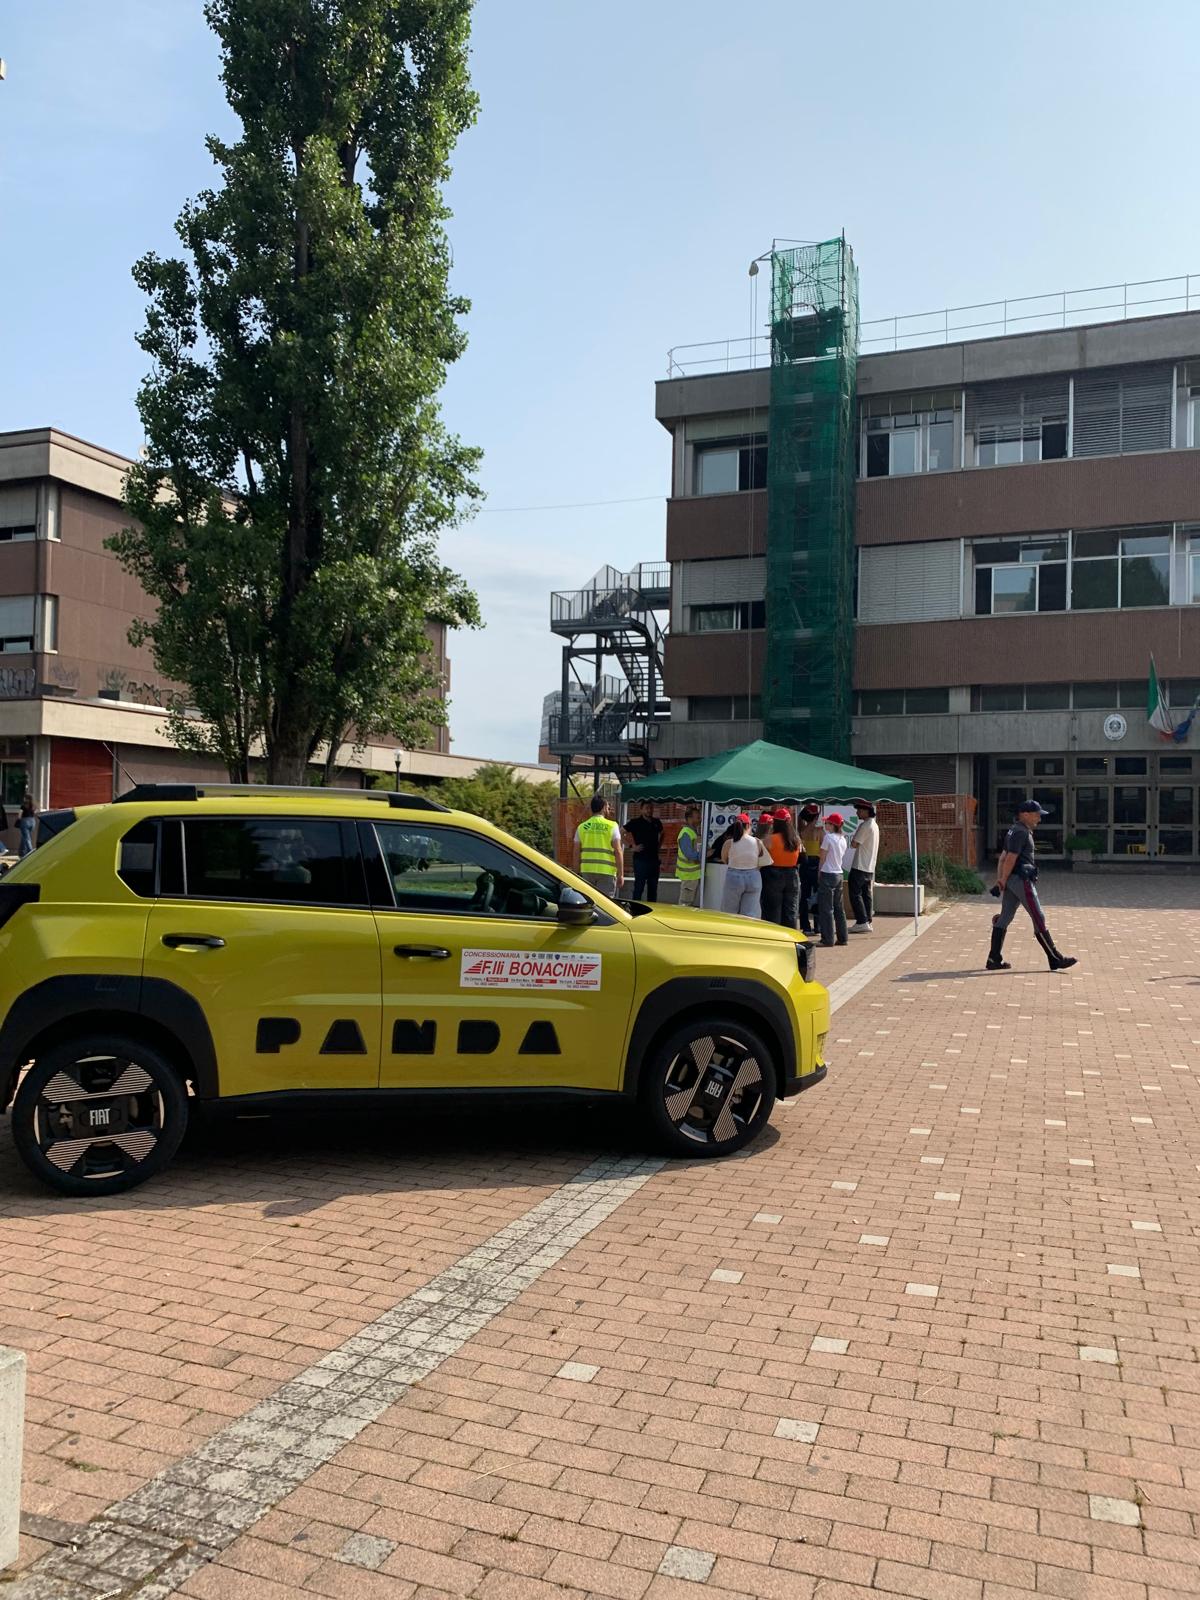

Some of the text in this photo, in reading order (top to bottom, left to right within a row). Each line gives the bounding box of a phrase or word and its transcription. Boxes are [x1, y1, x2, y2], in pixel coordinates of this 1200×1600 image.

[463, 951, 520, 959] CONCESSIONARIA
[509, 961, 583, 978] BONACINI
[255, 1016, 562, 1055] PANDA
[704, 1080, 724, 1098] FIAT
[89, 1108, 110, 1126] FIAT
